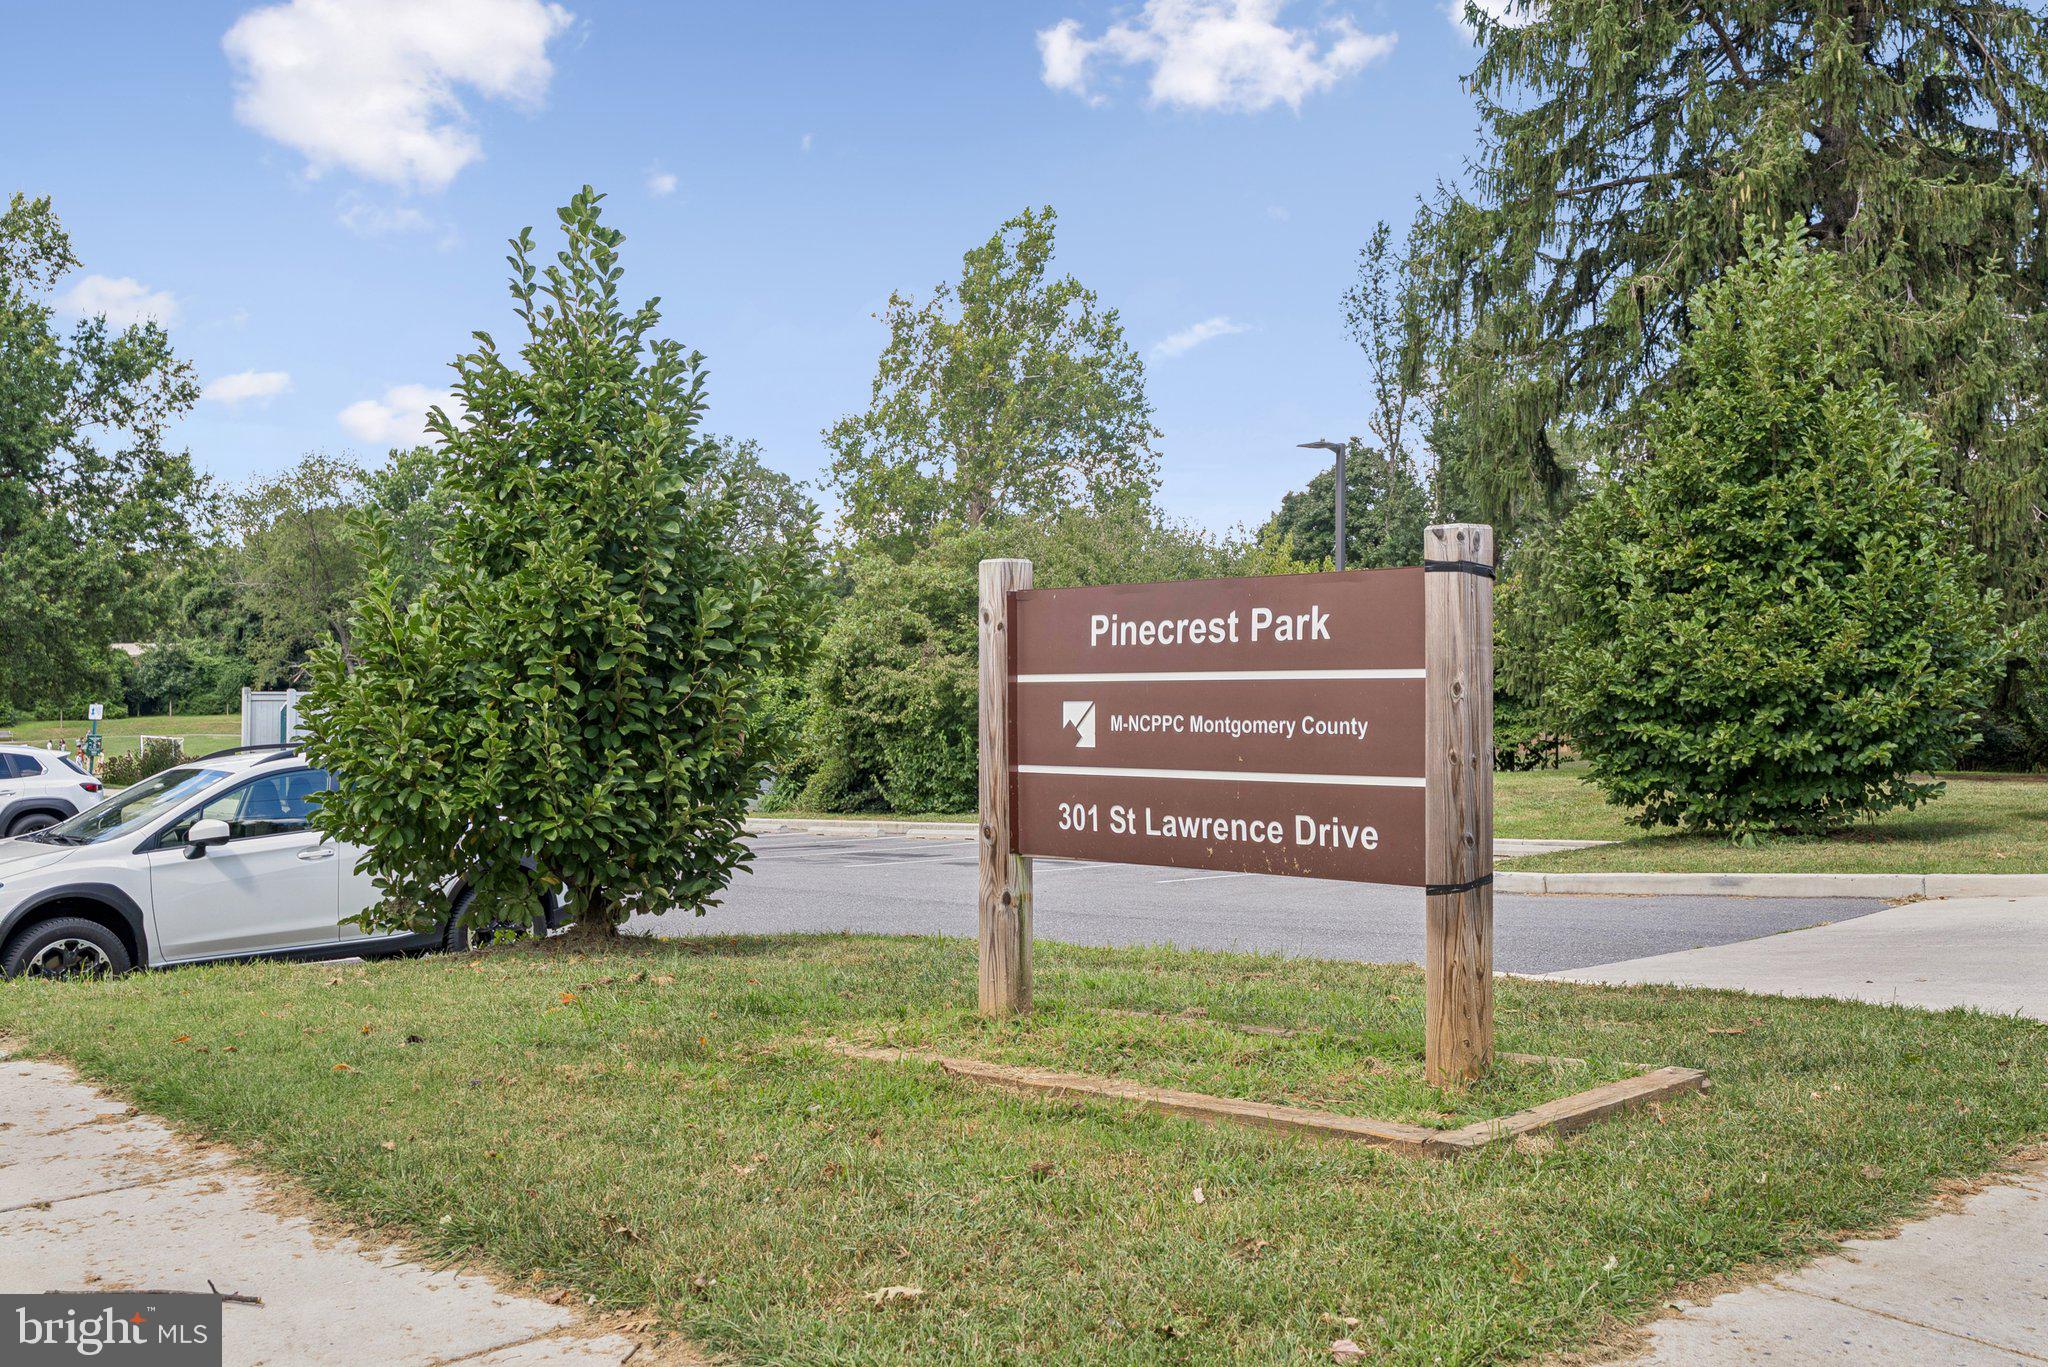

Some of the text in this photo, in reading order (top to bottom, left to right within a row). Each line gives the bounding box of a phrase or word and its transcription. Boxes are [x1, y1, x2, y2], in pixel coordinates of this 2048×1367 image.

[1090, 604, 1331, 647] Pinecrest Park
[1110, 714, 1369, 740] M-NCPPC Montgomery County
[1058, 802, 1379, 852] 301 St Lawrence Drive
